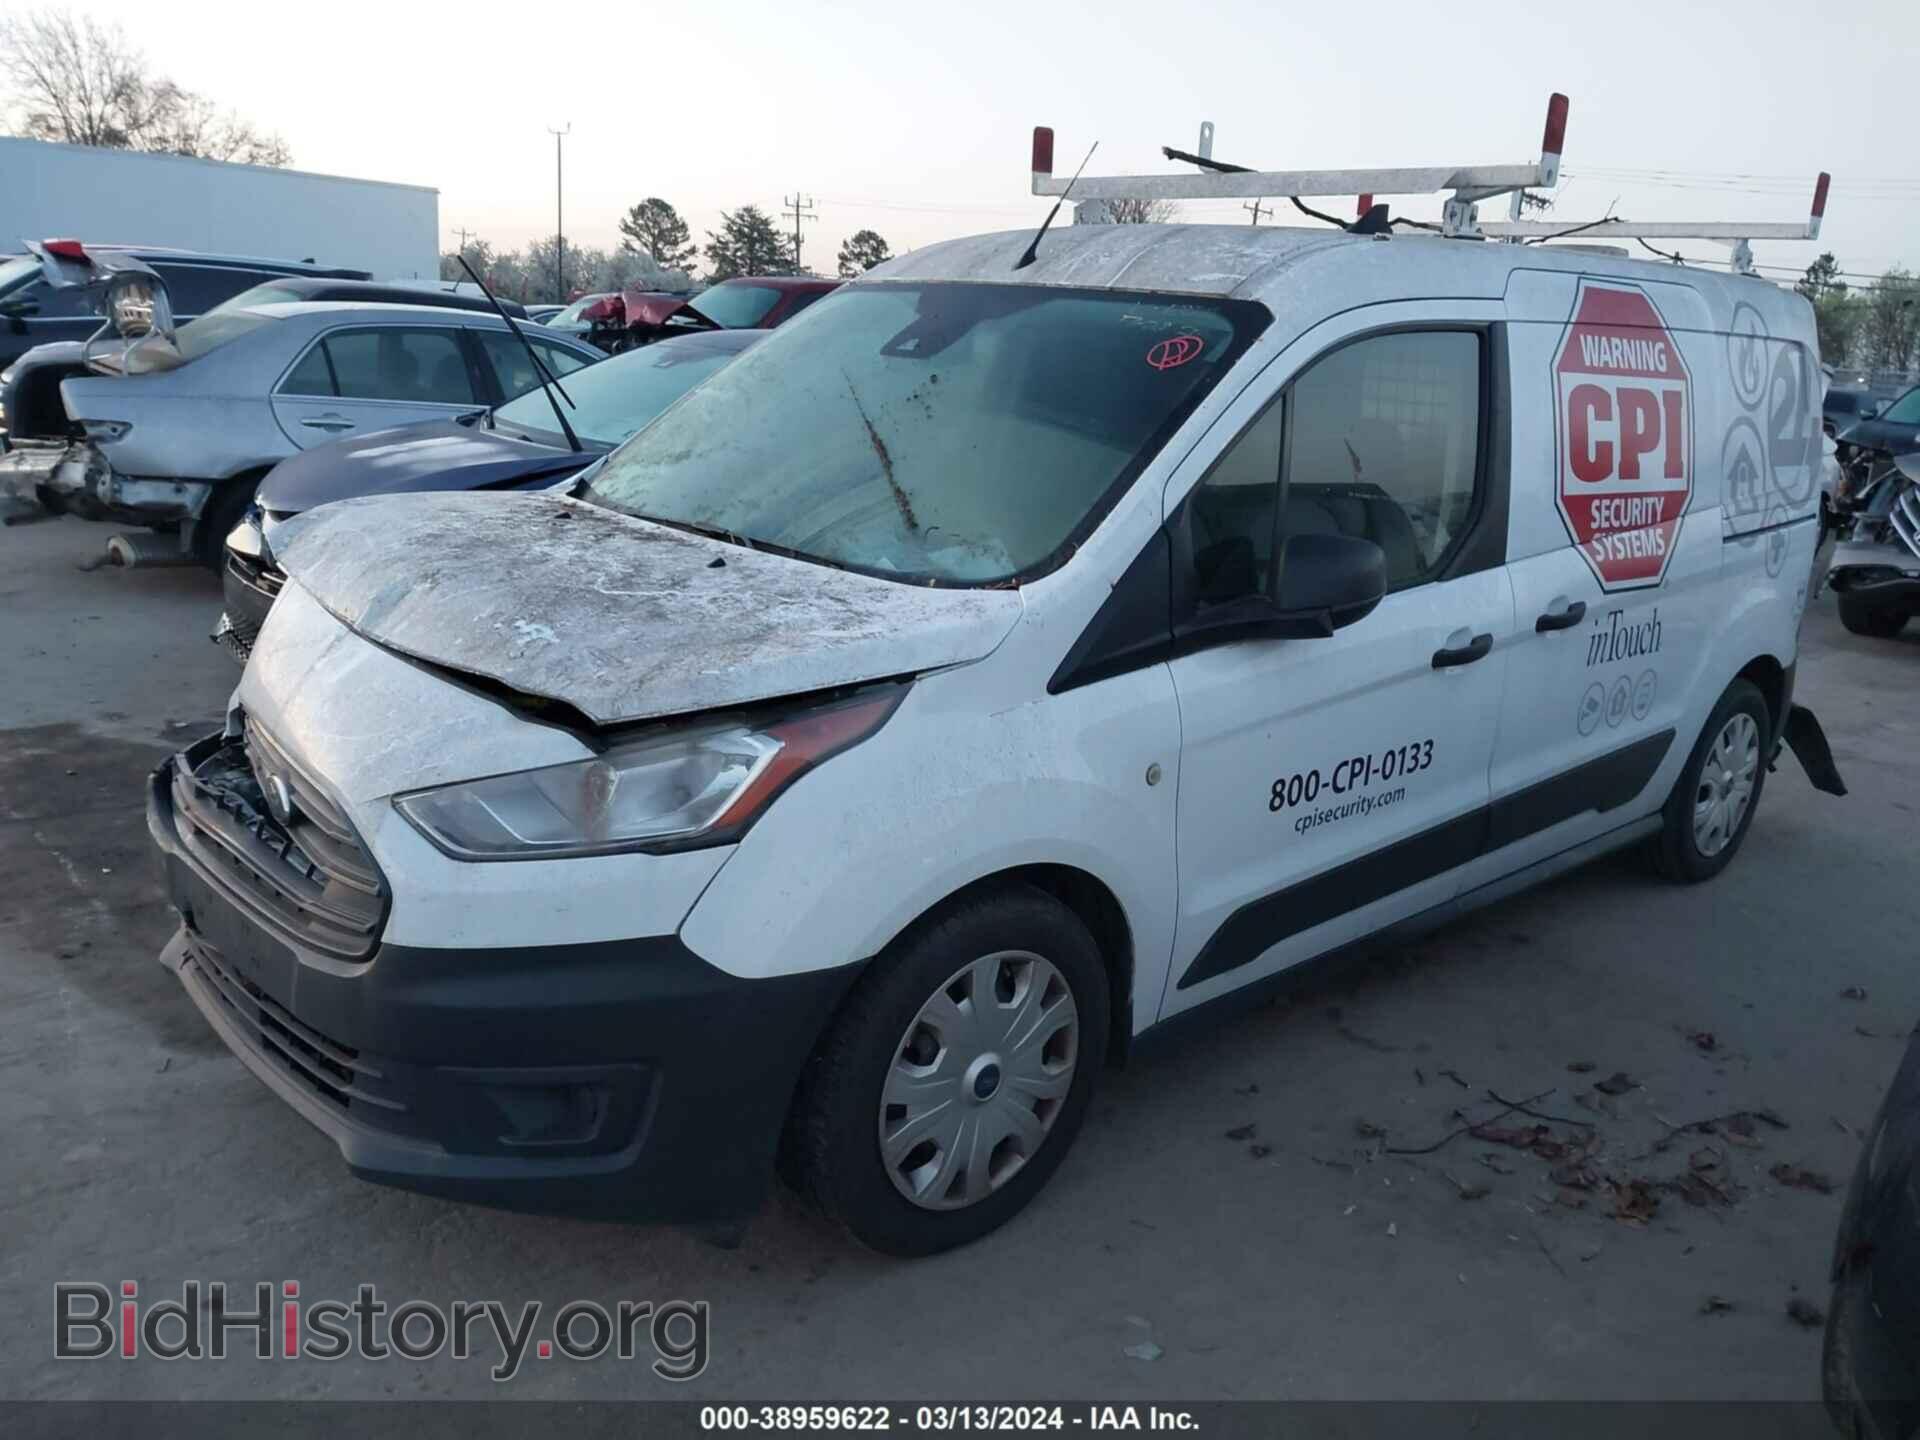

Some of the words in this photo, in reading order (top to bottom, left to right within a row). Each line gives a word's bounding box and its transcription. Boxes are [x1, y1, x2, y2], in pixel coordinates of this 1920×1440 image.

[1580, 334, 1667, 372] WARNING
[1568, 383, 1684, 483] CPI
[1590, 497, 1665, 529] SECURITY
[1592, 528, 1666, 562] SYSTEMS
[1586, 608, 1662, 668] inTouch
[1268, 739, 1434, 812] 800-CPI-0133
[1294, 787, 1406, 835] cpisecurity.com
